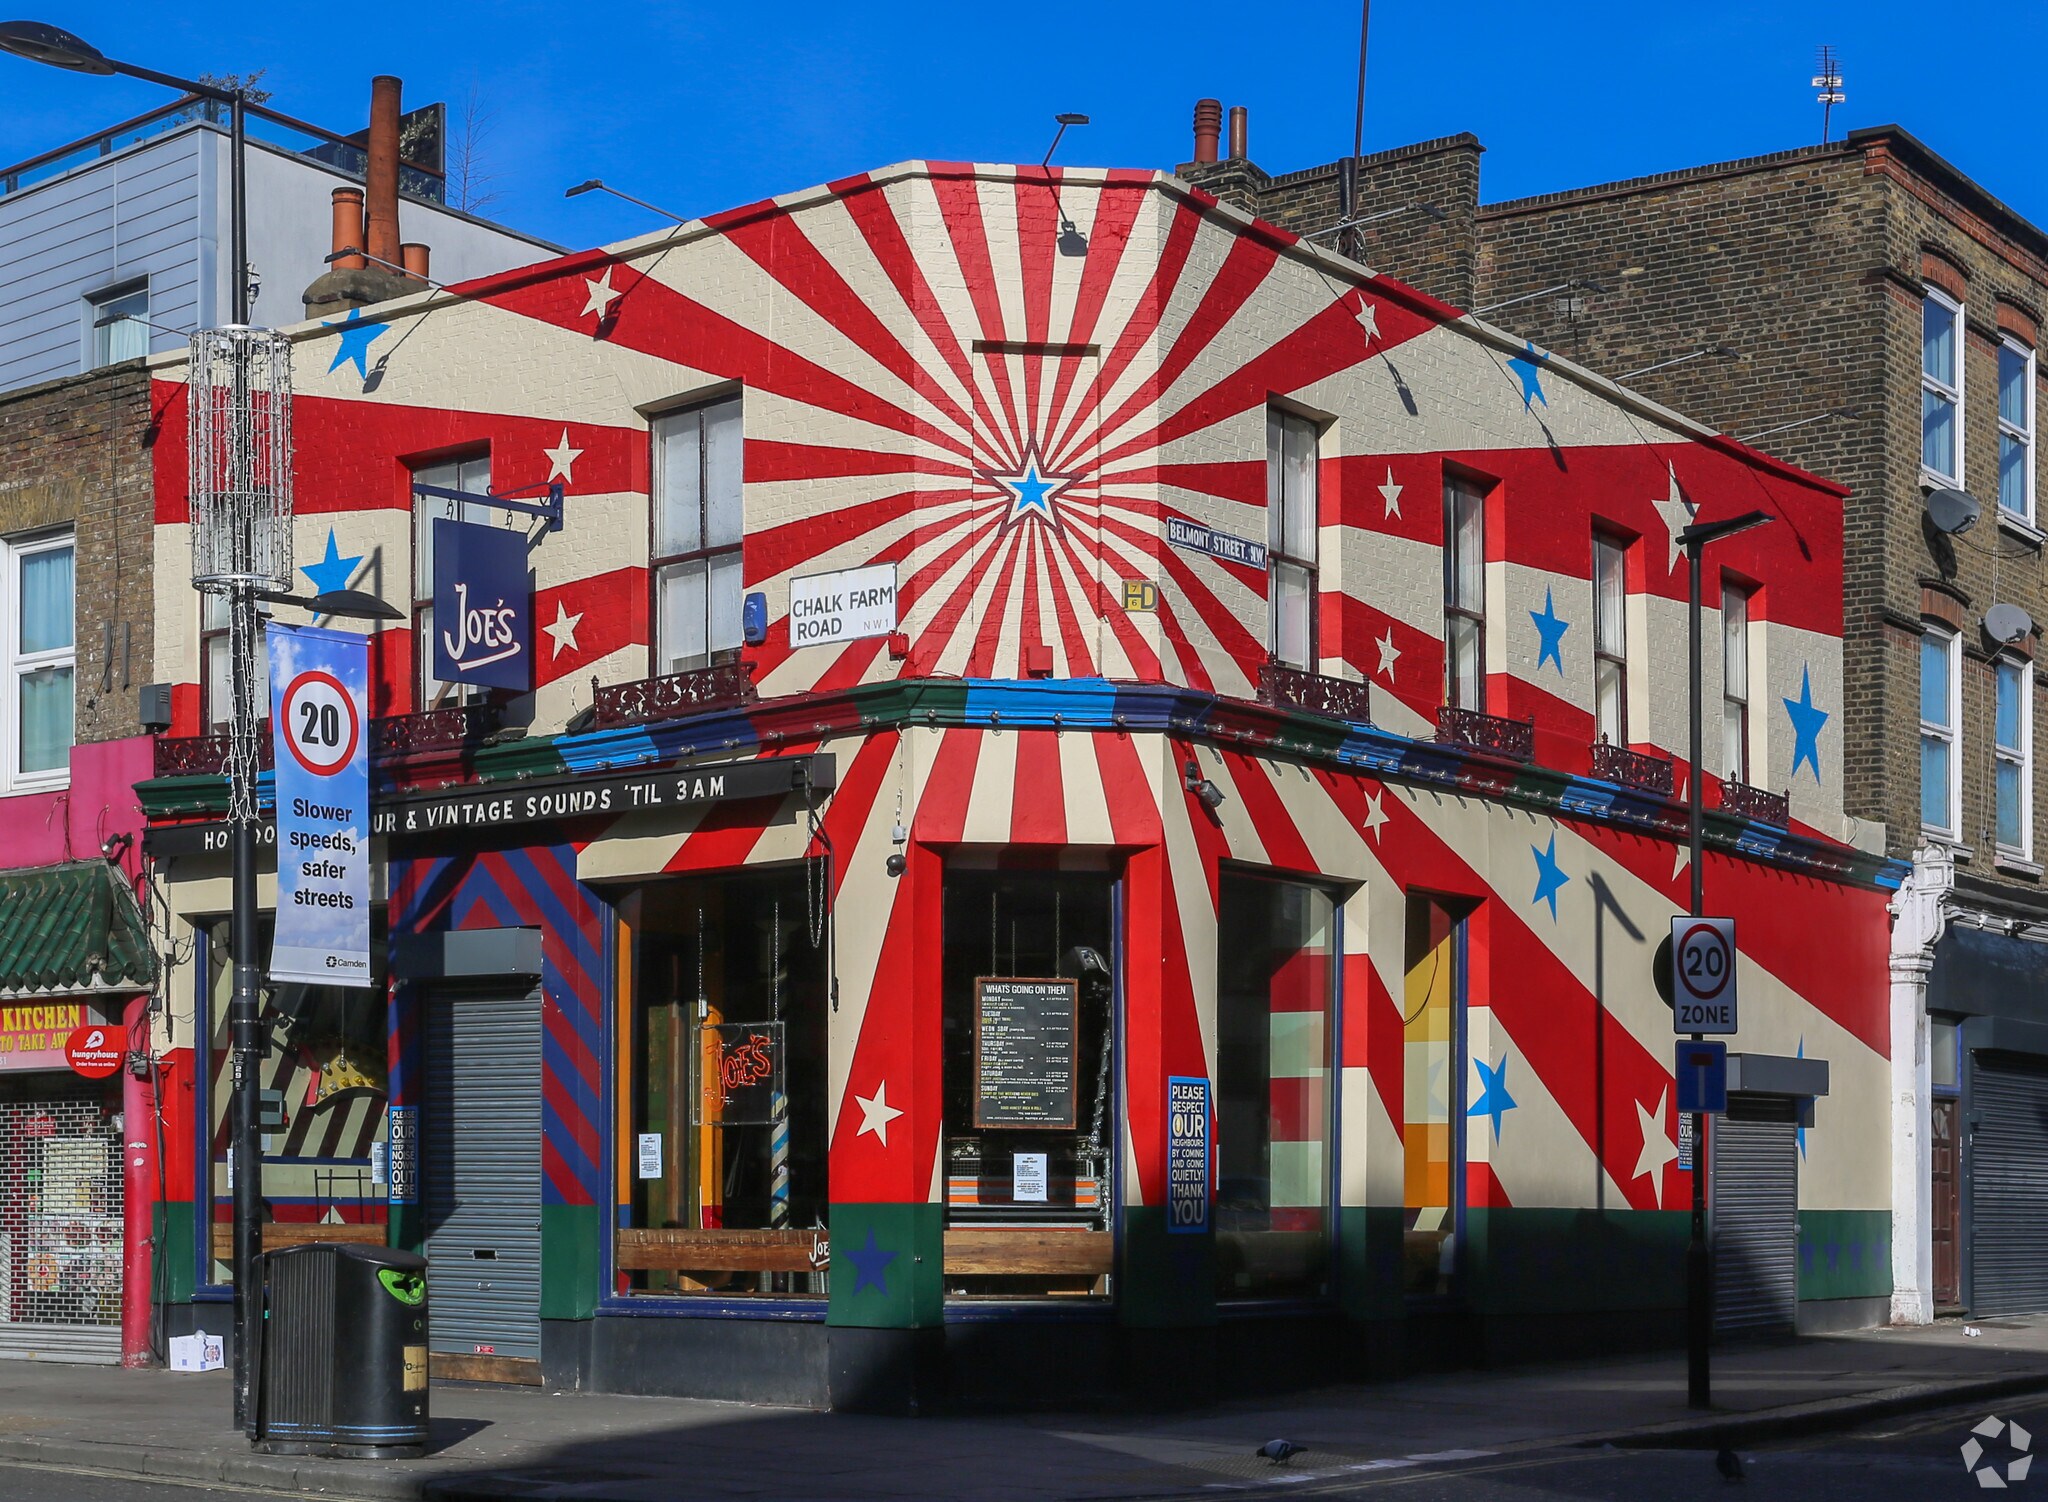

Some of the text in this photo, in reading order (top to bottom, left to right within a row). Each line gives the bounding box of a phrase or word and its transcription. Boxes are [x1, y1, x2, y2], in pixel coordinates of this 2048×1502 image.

[1170, 522, 1210, 549] BELMONT
[793, 586, 893, 618] CHALK FARM
[797, 617, 842, 640] ROAD
[300, 701, 340, 747] 20
[293, 798, 353, 822] Slower
[406, 810, 417, 830] &
[427, 800, 513, 826] VINTAGE
[527, 788, 611, 818] SOUNDS
[677, 776, 725, 800] 3AM
[289, 831, 356, 855] speeds,
[302, 860, 346, 879] safer
[294, 888, 353, 909] streets
[337, 959, 367, 968] Camden
[1686, 946, 1723, 977] 20
[1012, 986, 1034, 994] GOING
[1035, 986, 1046, 995] ON
[1047, 986, 1066, 995] THEN
[2, 1004, 80, 1032] KITCHEN
[1681, 1005, 1730, 1024] ZONE
[18, 1034, 46, 1051] TAKE
[72, 1049, 119, 1059] hungryhouse
[1172, 1086, 1204, 1100] PLEASE
[1172, 1102, 1204, 1113] RESPECT
[392, 1111, 415, 1119] PLEASE
[392, 1126, 415, 1138] OUR
[1172, 1113, 1204, 1137] OUR
[1172, 1138, 1204, 1147] NEIGHBOURS
[392, 1151, 415, 1161] NOISE
[1172, 1149, 1204, 1158] BY COMING
[392, 1161, 415, 1170] DOWN
[1172, 1159, 1204, 1168] AND GOING
[392, 1171, 415, 1184] OUT
[1172, 1170, 1204, 1181] QUIETLY!
[392, 1184, 415, 1195] HERE
[1172, 1184, 1204, 1198] THANK
[1172, 1200, 1204, 1223] YOU
